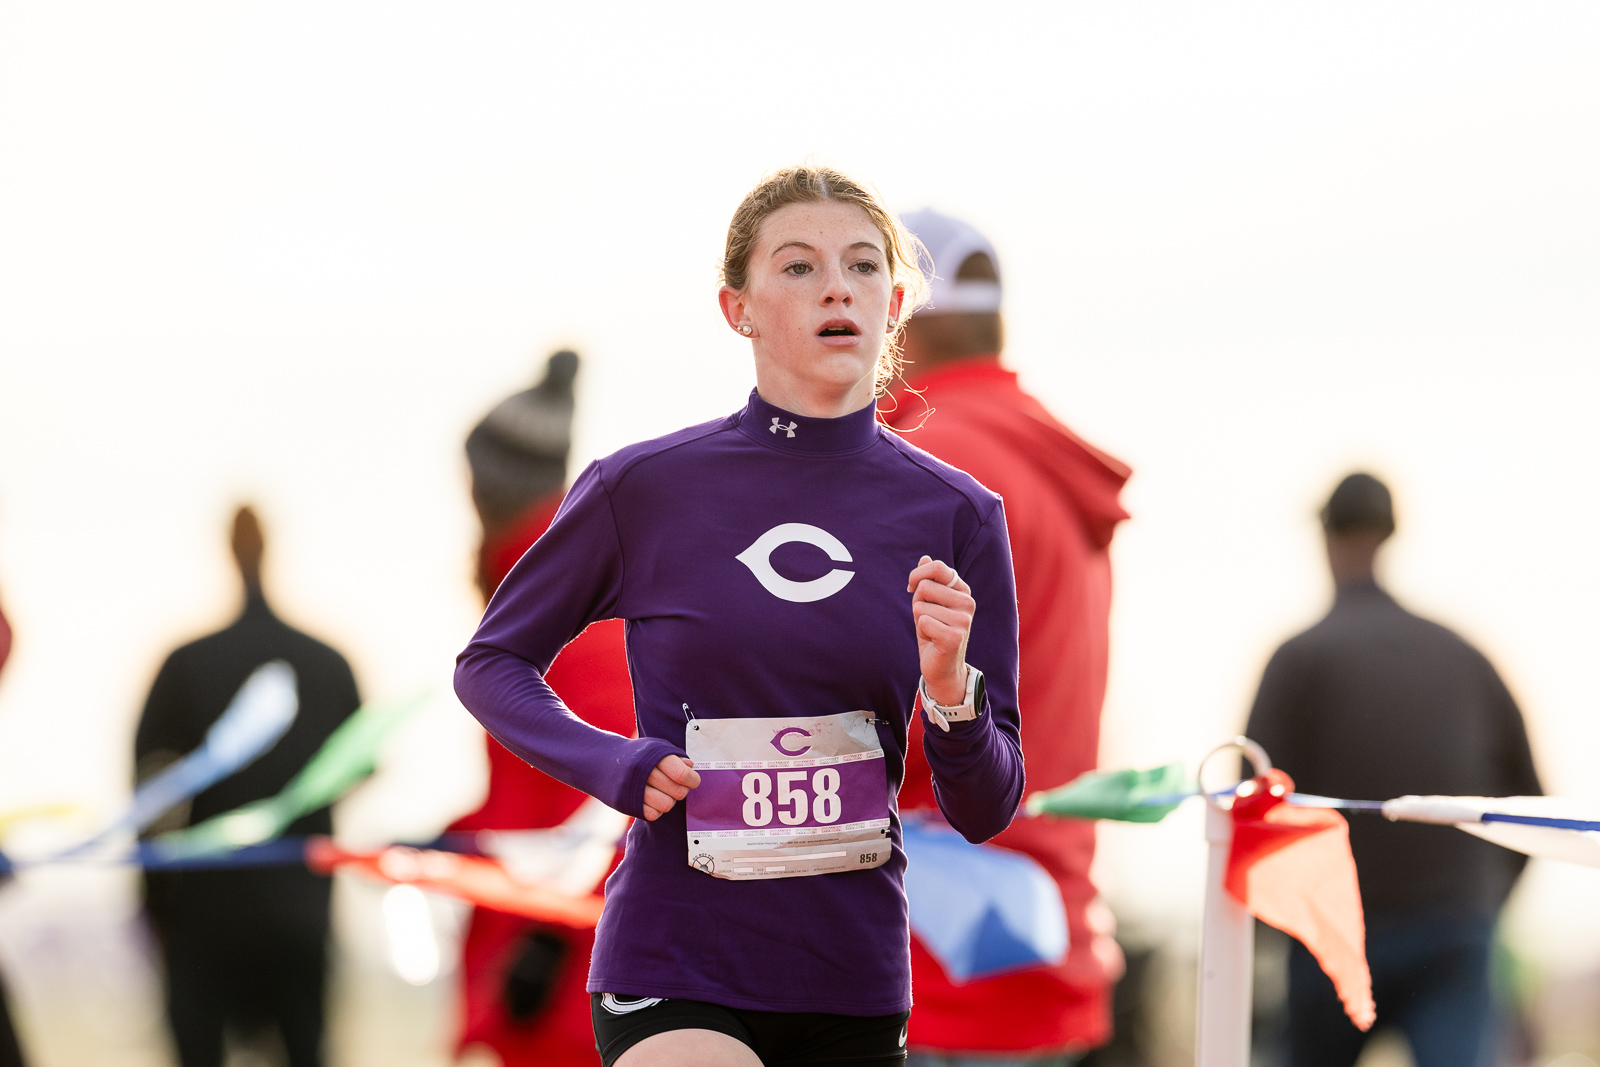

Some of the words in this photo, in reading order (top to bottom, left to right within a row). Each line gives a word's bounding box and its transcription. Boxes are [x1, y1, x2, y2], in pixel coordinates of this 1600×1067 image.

[735, 522, 856, 603] C
[770, 727, 812, 757] C
[741, 768, 842, 827] 858
[859, 852, 878, 864] 858
